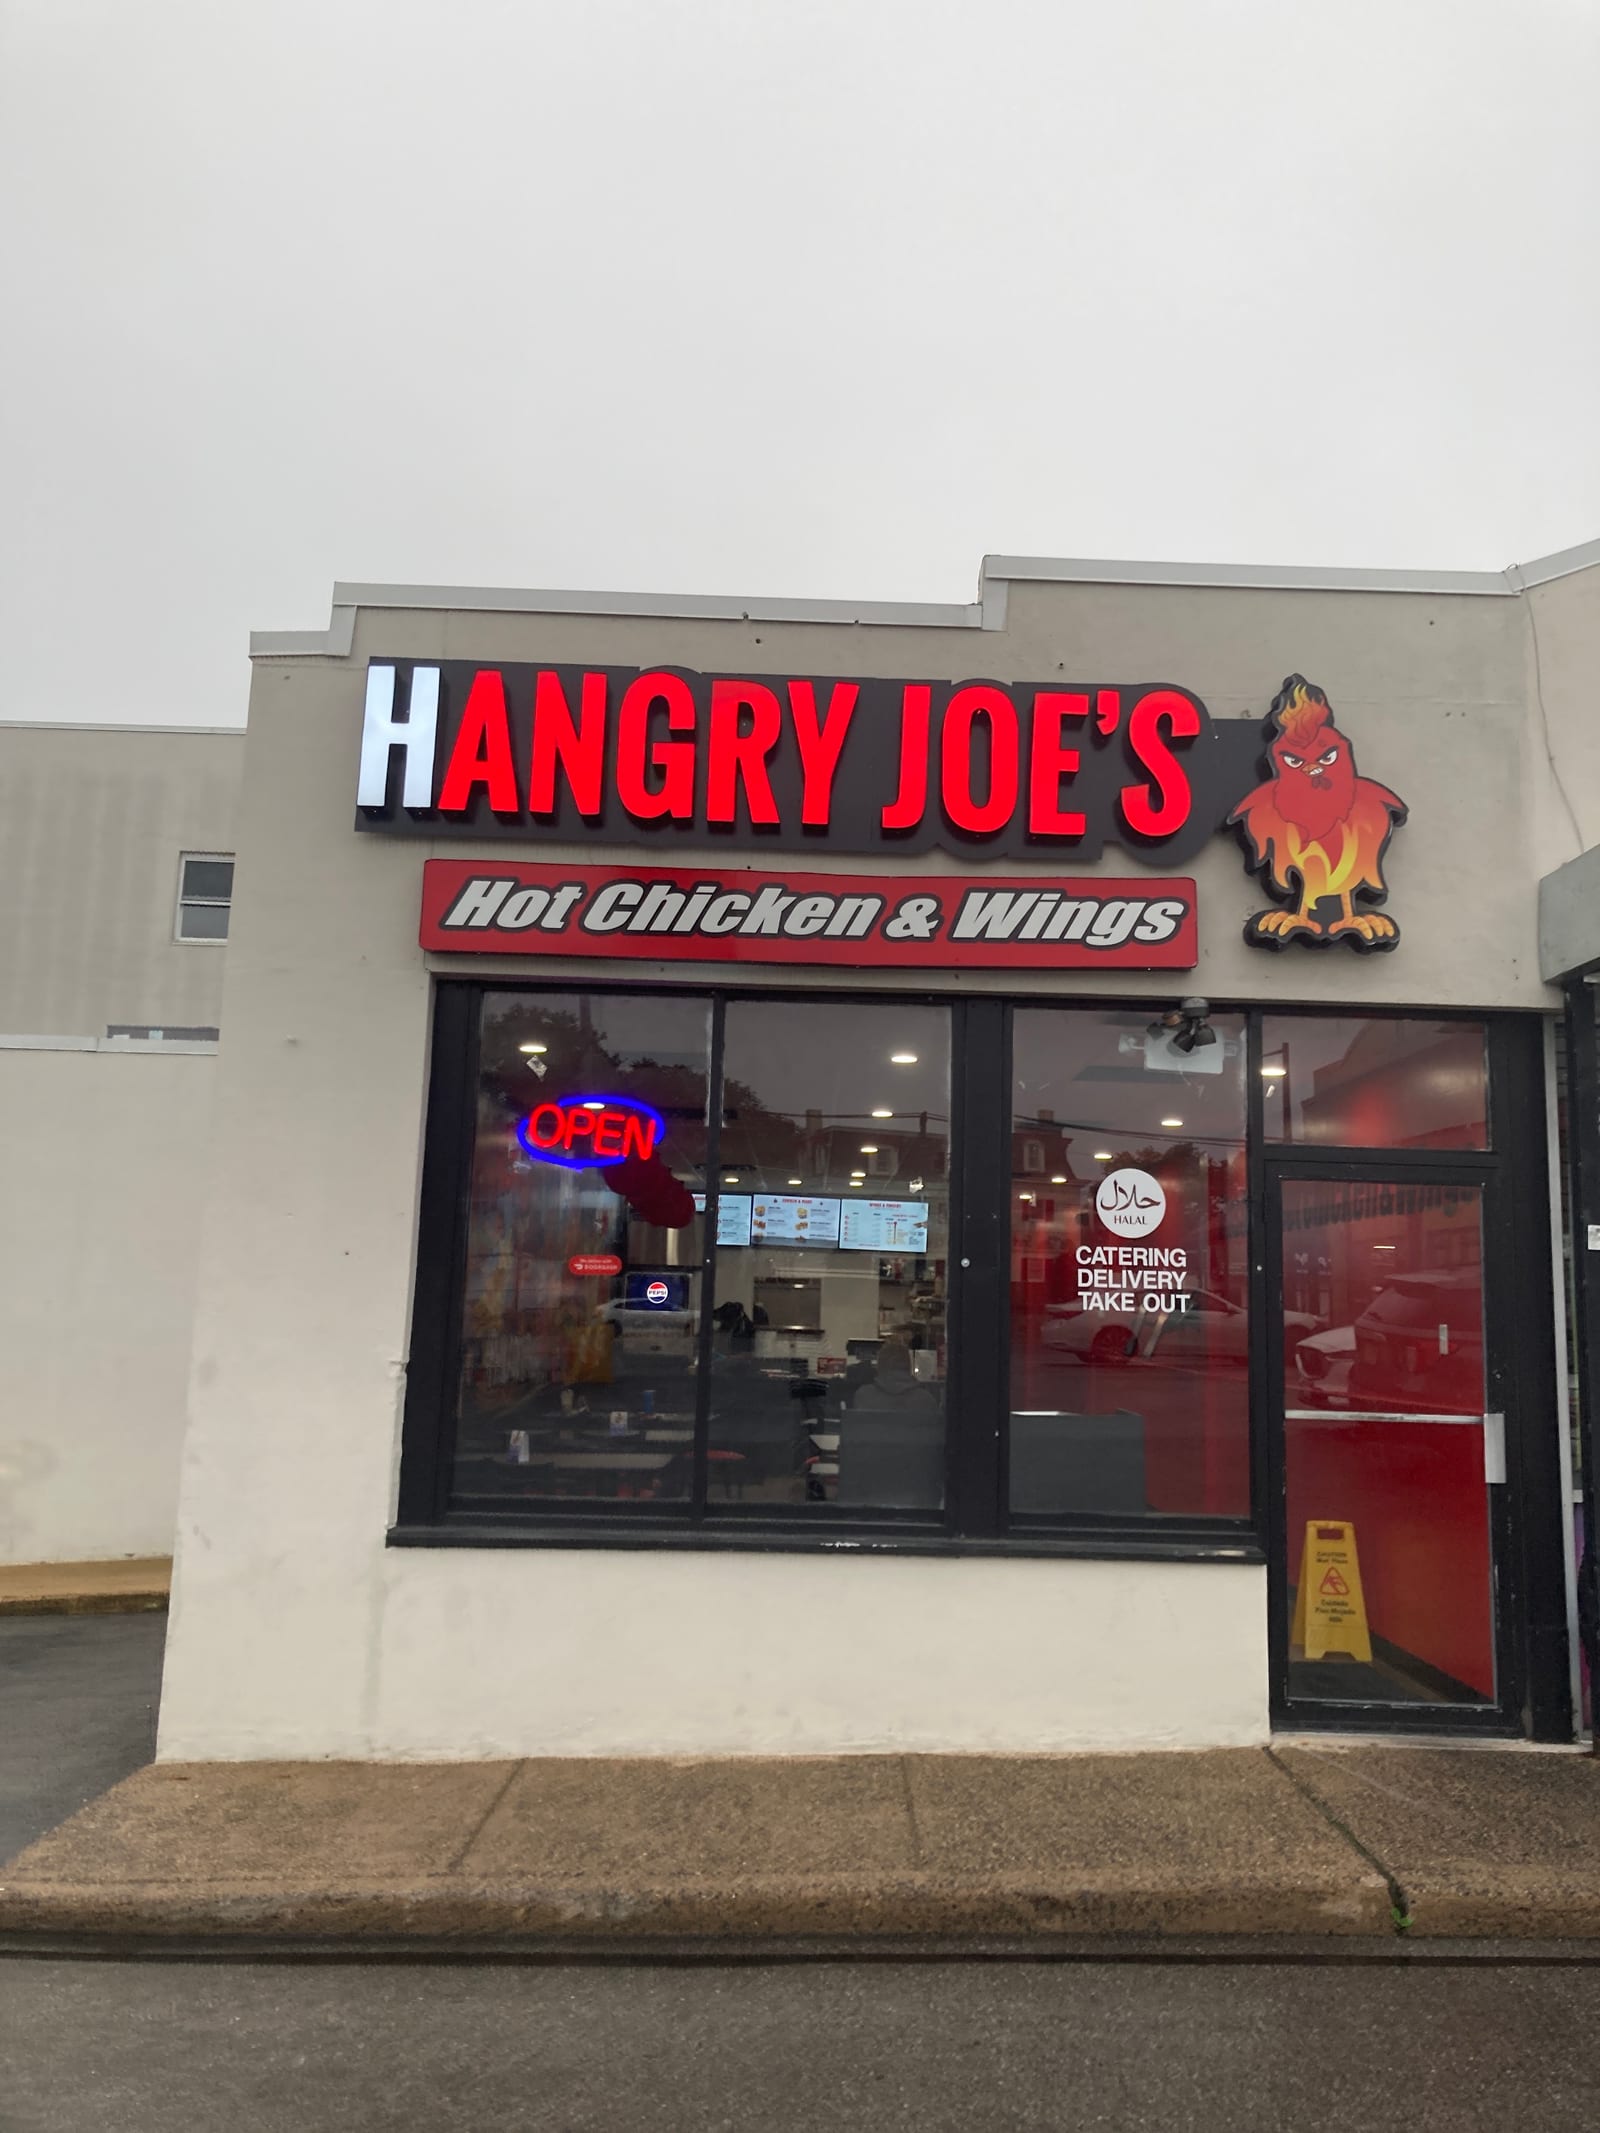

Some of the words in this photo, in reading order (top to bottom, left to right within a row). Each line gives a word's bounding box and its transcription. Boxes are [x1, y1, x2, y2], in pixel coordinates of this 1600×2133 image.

[357, 665, 860, 824] HANGRY
[881, 684, 1200, 836] JOE'S
[445, 880, 583, 930] Hot
[583, 883, 882, 937] Chicken
[885, 897, 940, 939] &
[952, 891, 1184, 946] Wings
[529, 1103, 656, 1160] OPEN
[1100, 1179, 1161, 1212] حلال
[1113, 1215, 1148, 1225] HALAL
[1075, 1245, 1187, 1268] CATERING
[1077, 1268, 1187, 1290] DELIVERY
[1077, 1291, 1136, 1312] TAKE
[1143, 1293, 1191, 1313] OUT
